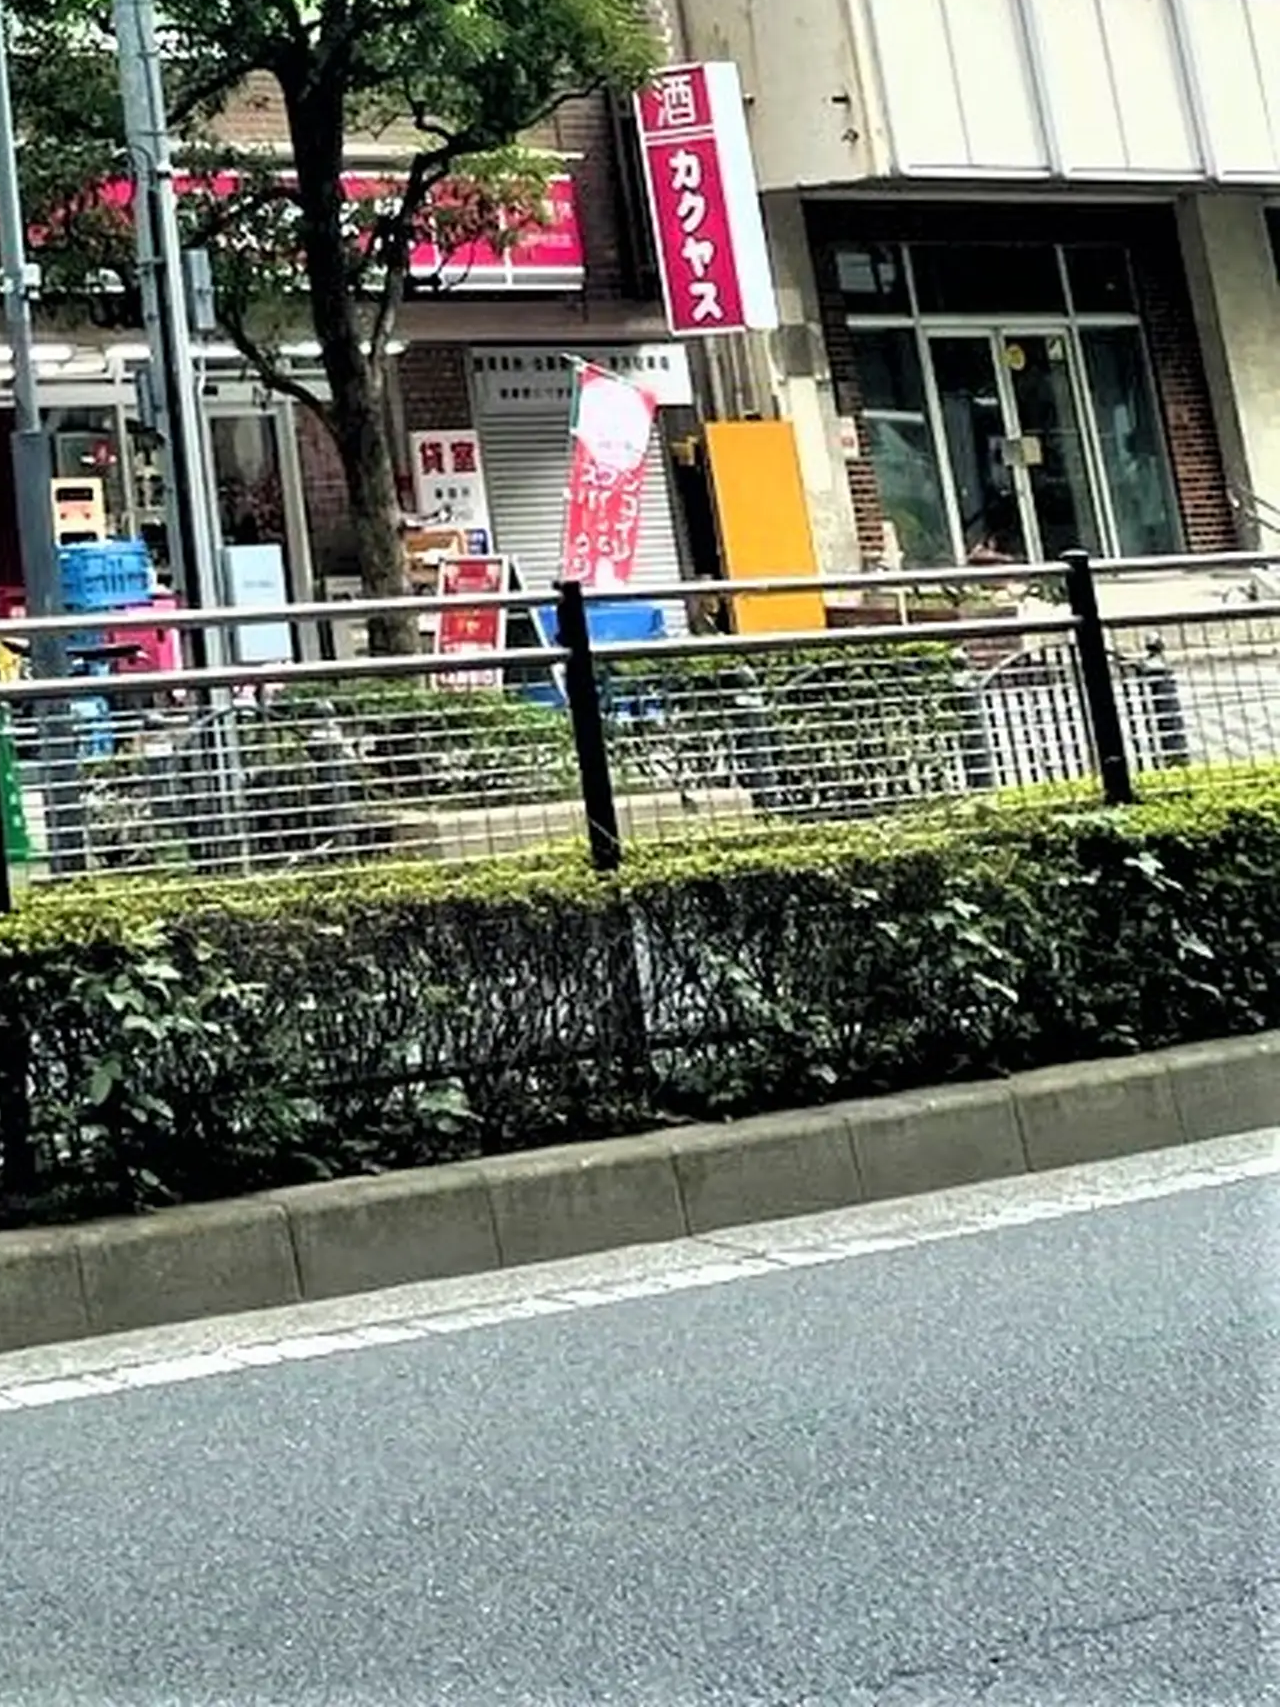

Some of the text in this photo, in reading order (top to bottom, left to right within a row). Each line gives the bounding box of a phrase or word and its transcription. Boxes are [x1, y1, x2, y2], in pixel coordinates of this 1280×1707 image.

[652, 75, 697, 128] 酒
[668, 147, 724, 323] カクヤス
